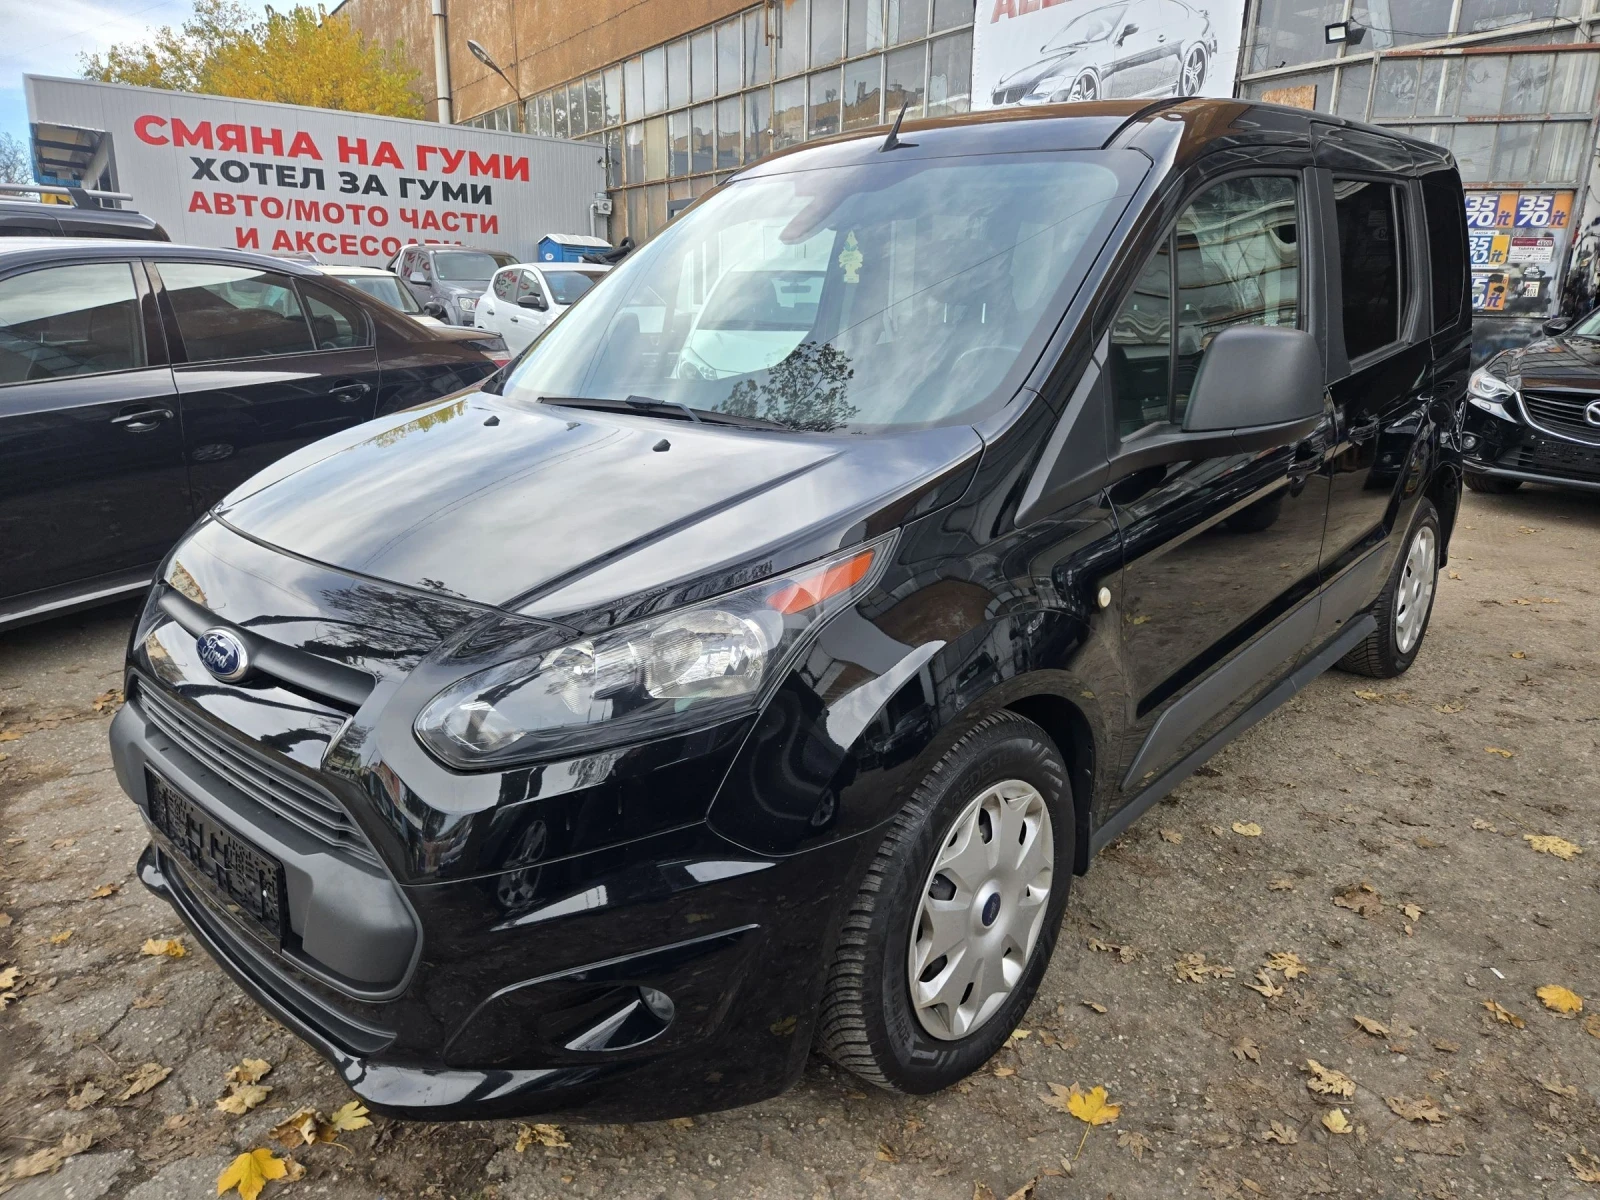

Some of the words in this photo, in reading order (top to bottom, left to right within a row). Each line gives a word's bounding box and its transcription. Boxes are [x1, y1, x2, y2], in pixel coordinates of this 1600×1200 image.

[133, 115, 324, 161] СМЯНА
[337, 135, 405, 170] НА
[416, 144, 530, 182] ГУМИ
[189, 156, 326, 191] ХОТЕЛ
[338, 171, 389, 197] ЗА
[399, 177, 493, 206] ГУМИ
[1466, 196, 1499, 212] 35
[1519, 195, 1553, 211] 35
[188, 191, 389, 227] АВТО/МОТО
[400, 208, 499, 235] ЧАСТИ
[1496, 210, 1512, 226] it
[1550, 210, 1566, 226] it
[235, 227, 260, 250] И
[1490, 249, 1503, 262] it
[1486, 291, 1501, 307] it
[202, 636, 230, 669] Ford
